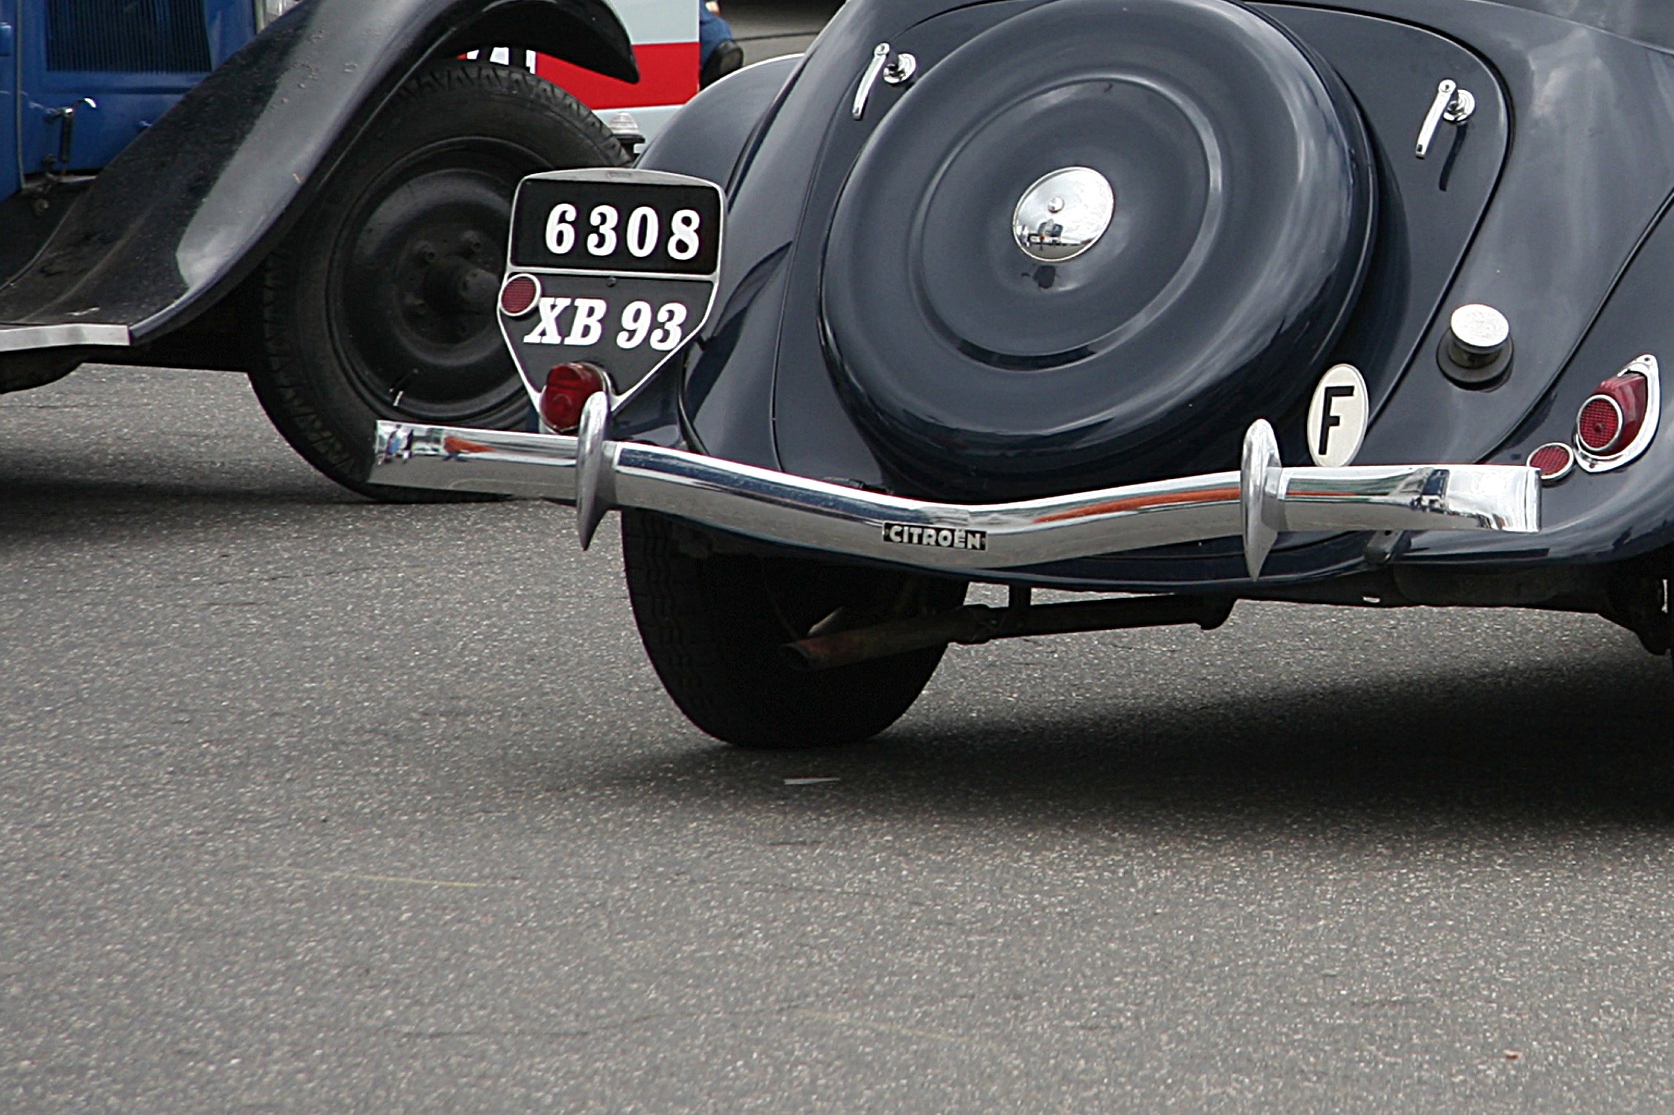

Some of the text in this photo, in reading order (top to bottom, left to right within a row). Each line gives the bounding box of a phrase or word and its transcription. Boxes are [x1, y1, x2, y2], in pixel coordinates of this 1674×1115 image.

[545, 203, 700, 260] 6308
[523, 297, 687, 351] XB 93
[1318, 385, 1355, 456] F
[889, 525, 981, 549] CITROËN
